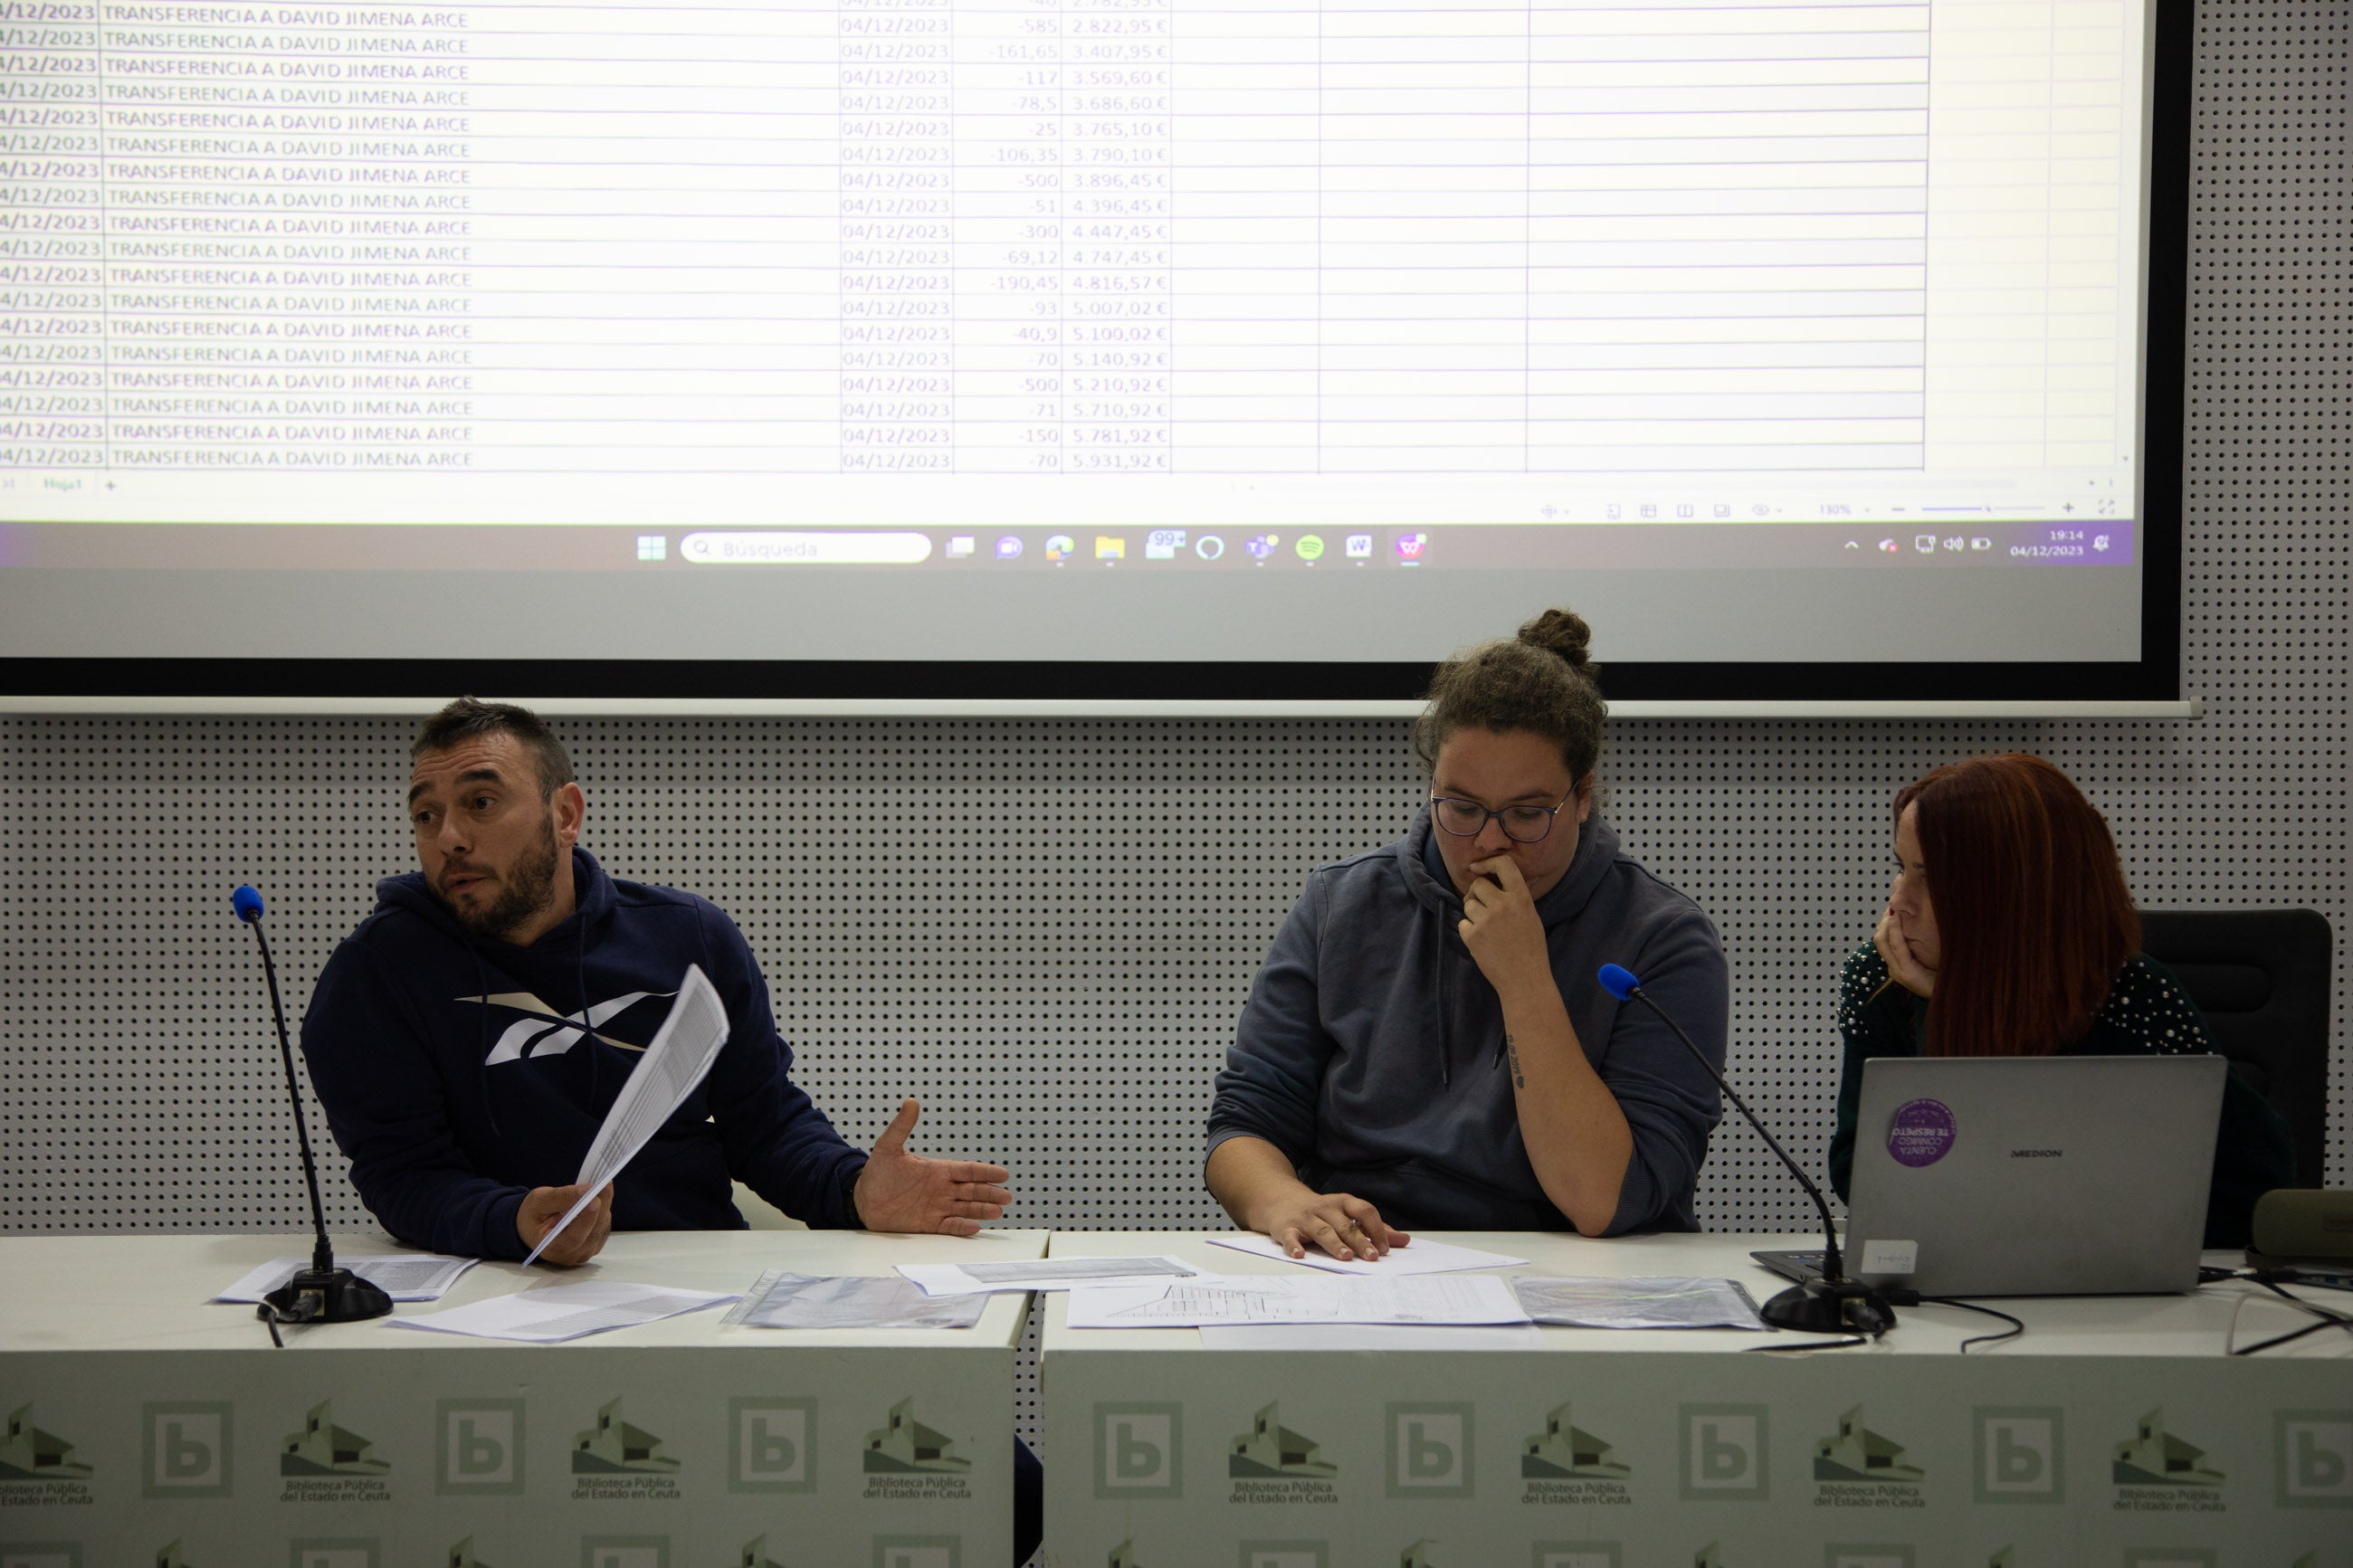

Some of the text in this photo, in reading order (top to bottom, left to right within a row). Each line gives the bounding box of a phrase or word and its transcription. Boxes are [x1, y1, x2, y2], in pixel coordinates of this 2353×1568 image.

[0, 3, 95, 23] /12/2023
[103, 4, 471, 28] TRANSFERENCIA A DAVID JIMENA ARCE
[842, 17, 948, 34] 04/12/2023
[1072, 19, 1152, 35] 2.822,95
[0, 54, 96, 73] /12/2023
[105, 57, 471, 80] TRANSFERENCIA A DAVID JIMENA ARCE
[842, 69, 948, 86] 04/12/2023
[1072, 71, 1152, 87] 3.569,60
[0, 107, 97, 126] 4/12/2023
[106, 109, 471, 131] TRANSFERENCIA A DAVID JIMENA ARCE
[842, 121, 948, 138] 04/12/2023
[1072, 122, 1152, 138] 3.765,10
[0, 185, 99, 204] 4/12/2023
[108, 189, 472, 209] TRANSFERENCIA A DAVID JIMENA ARCE
[842, 198, 949, 215] 04/12/2023
[1072, 200, 1152, 216] 4.396,45
[0, 264, 100, 282] 4/12/2023
[109, 266, 472, 287] TRANSFERENCIA A DAVID JIMENA ARCE
[843, 275, 949, 292] 04/12/2023
[1073, 276, 1152, 292] 4.816,57
[0, 317, 100, 334] 4/12/2023
[110, 318, 472, 338] TRANSFERENCIA A DAVID JIMENA ARCE
[843, 327, 949, 343] 04/12/2023
[1073, 328, 1152, 344] 5.100,02
[0, 394, 102, 413] 4/12/2023
[111, 396, 472, 414] TRANSFERENCIA A DAVID JIMENA ARCE
[843, 403, 949, 419] 04/12/2023
[1073, 404, 1152, 420] 5.710,92
[112, 449, 472, 466] TRANSFERENCIA A DAVID JIMENA ARCE
[843, 453, 950, 470] 04/12/2023
[1073, 454, 1152, 470] 5.931,92
[2049, 530, 2083, 540] 19:14
[723, 541, 817, 559] Búsqueda
[2009, 545, 2083, 556] 04/12/2023
[1897, 1136, 1942, 1146] CONMIGO
[1900, 1145, 1937, 1155] CUENTA
[2010, 1150, 2063, 1158] MEDION
[0, 1483, 87, 1494] blioteca Pública
[286, 1479, 385, 1491] Biblioteca Pública
[577, 1477, 675, 1488] Biblioteca Pública
[869, 1477, 966, 1488] Biblioteca Pública
[1234, 1481, 1332, 1493] Biblioteca Pública
[1528, 1482, 1625, 1494] Biblioteca Pública
[281, 1491, 391, 1501] del Estado en Ceuta
[572, 1488, 590, 1498] del
[592, 1488, 629, 1498] Estado
[648, 1489, 681, 1498] Ceuta
[863, 1487, 881, 1498] del
[883, 1488, 920, 1498] Estado
[938, 1489, 972, 1498] Ceuta
[1229, 1492, 1338, 1504] del Estado en Ceuta
[1521, 1494, 1539, 1504] del
[1541, 1494, 1579, 1504] Estado
[1598, 1496, 1632, 1504] Ceuta
[1820, 1485, 1920, 1497] Biblioteca Pública
[2120, 1489, 2176, 1500] Biblioteca
[1, 1496, 93, 1506] Estado en Ceuta
[1814, 1496, 1926, 1507] del Estado en Ceuta
[2114, 1500, 2226, 1512] del Estado en Ceuta
